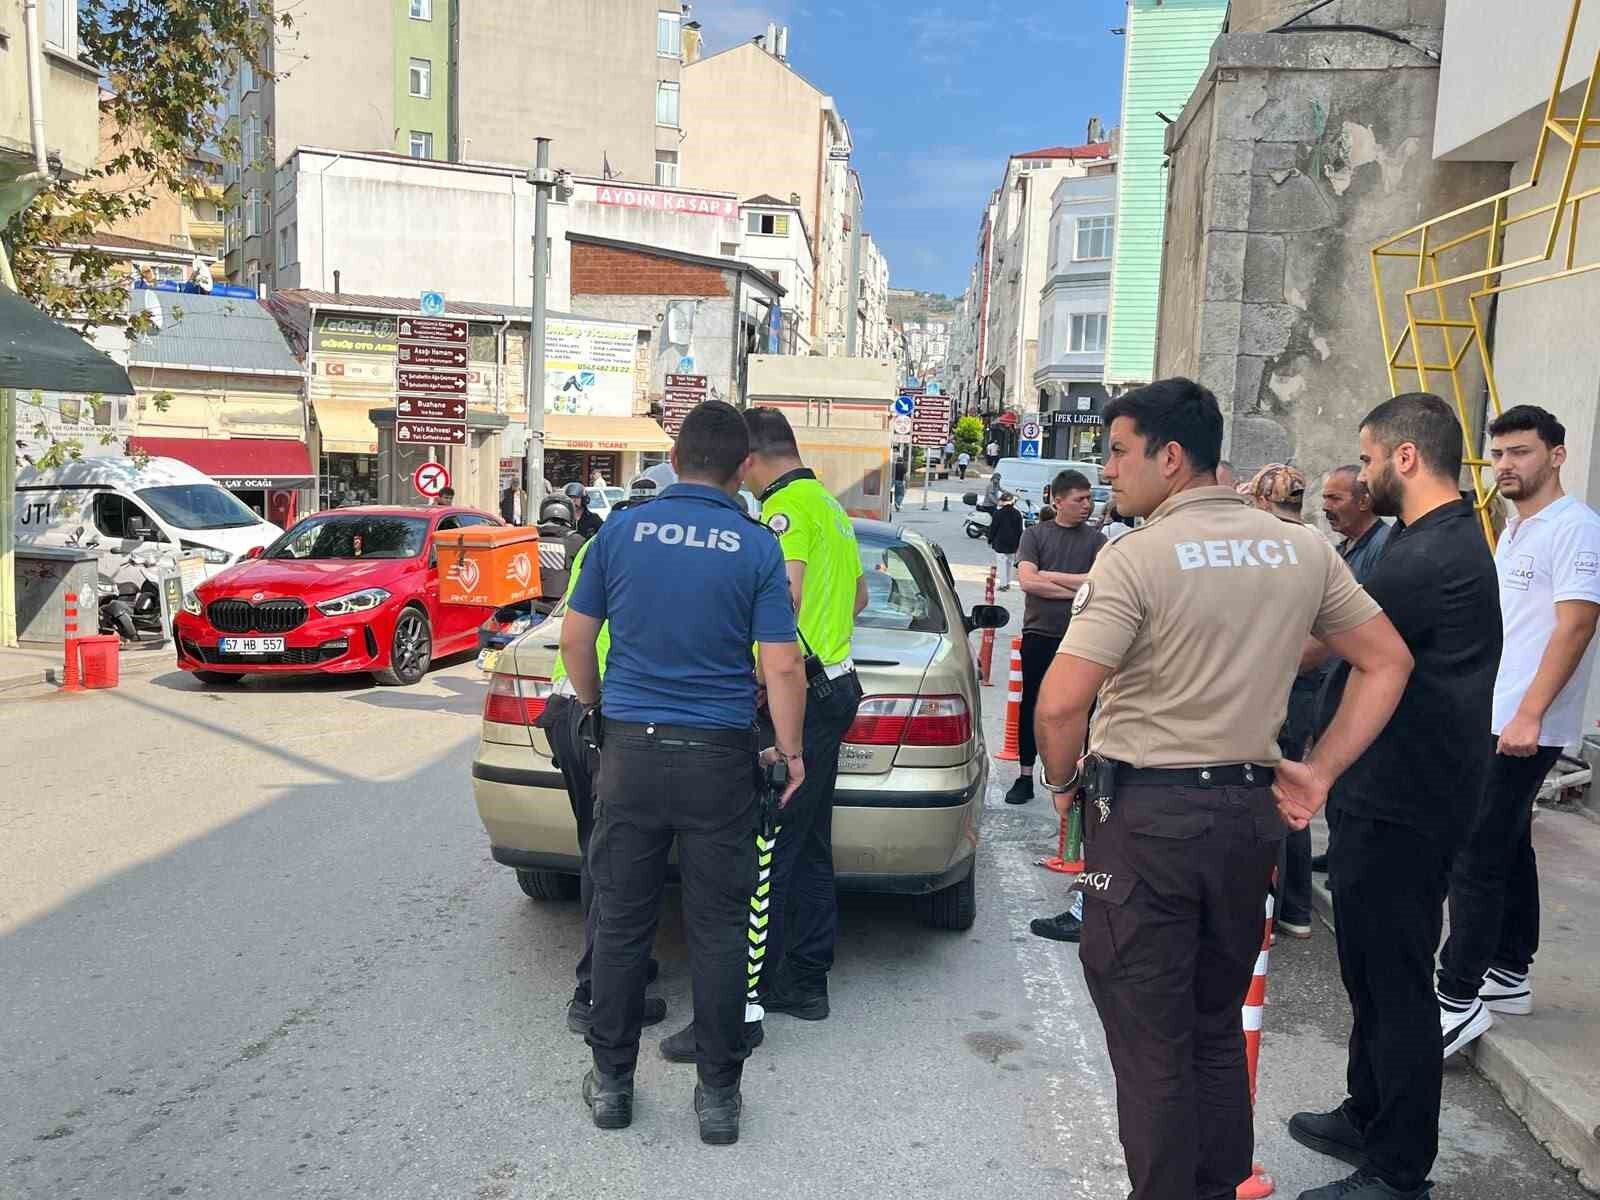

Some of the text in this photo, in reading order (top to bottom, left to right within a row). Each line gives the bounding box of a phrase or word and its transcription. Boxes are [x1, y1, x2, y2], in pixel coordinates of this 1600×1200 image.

[601, 189, 720, 212] AYDIN KASAP
[355, 342, 373, 350] OTO
[431, 348, 454, 356] Hamam
[225, 479, 242, 488] ÇAY
[244, 478, 272, 487] OCAĞI
[225, 639, 282, 650] 57 HB 557
